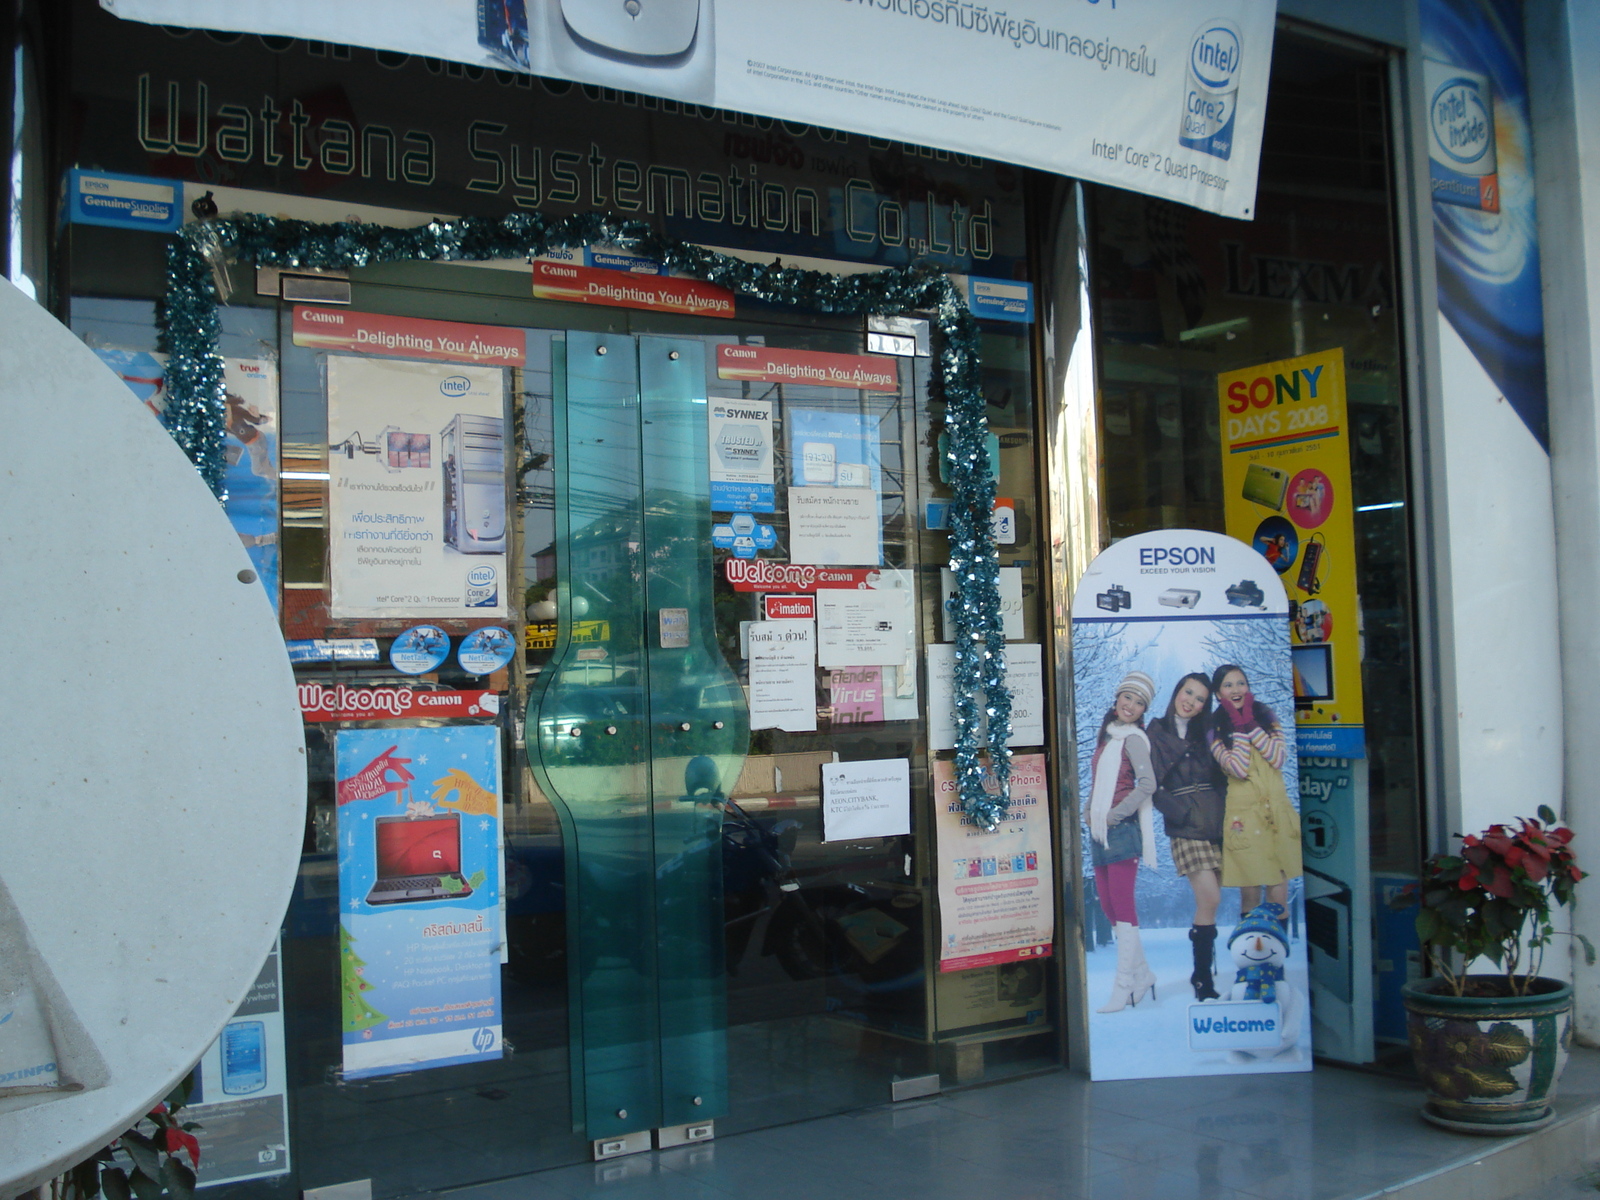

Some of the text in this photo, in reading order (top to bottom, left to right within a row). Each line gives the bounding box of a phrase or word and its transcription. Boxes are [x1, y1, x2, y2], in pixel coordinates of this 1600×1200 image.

[1200, 35, 1233, 74] intel
[1185, 115, 1207, 136] Quad
[138, 73, 435, 185] Wattana
[466, 119, 820, 237] Systemation
[1164, 157, 1188, 180] Quad
[1190, 164, 1230, 191] Processor
[85, 181, 109, 190] EPSON
[1430, 178, 1494, 207] pentium 4
[540, 264, 578, 278] Canon
[588, 282, 730, 312] Delighting You Always
[301, 310, 344, 324] Canon
[357, 329, 519, 359] Delighting You Always
[724, 347, 757, 359] Canon
[240, 364, 260, 373] true
[767, 362, 892, 385] Delighting You Always
[443, 378, 467, 392] intel
[1227, 364, 1324, 414] SONY
[726, 408, 769, 421] SYNNEX
[1227, 404, 1329, 441] DAYS 2008
[721, 435, 755, 447] TRUSTED
[1139, 546, 1216, 566] EPSON
[470, 569, 491, 582] intel
[726, 559, 853, 589] Welcome Canon
[431, 595, 460, 603] Processor
[779, 602, 811, 615] imation
[750, 631, 783, 642] รับสมัร
[400, 653, 428, 662] NetTalk
[468, 654, 494, 662] NetTalk
[297, 684, 462, 715] Welcome Canon
[831, 687, 877, 704] Virus
[1010, 775, 1041, 787] Phone
[1308, 817, 1325, 826] No.
[257, 981, 277, 989] work
[436, 976, 447, 984] PC
[1193, 1017, 1275, 1034] Welcome
[476, 1027, 492, 1053] hp
